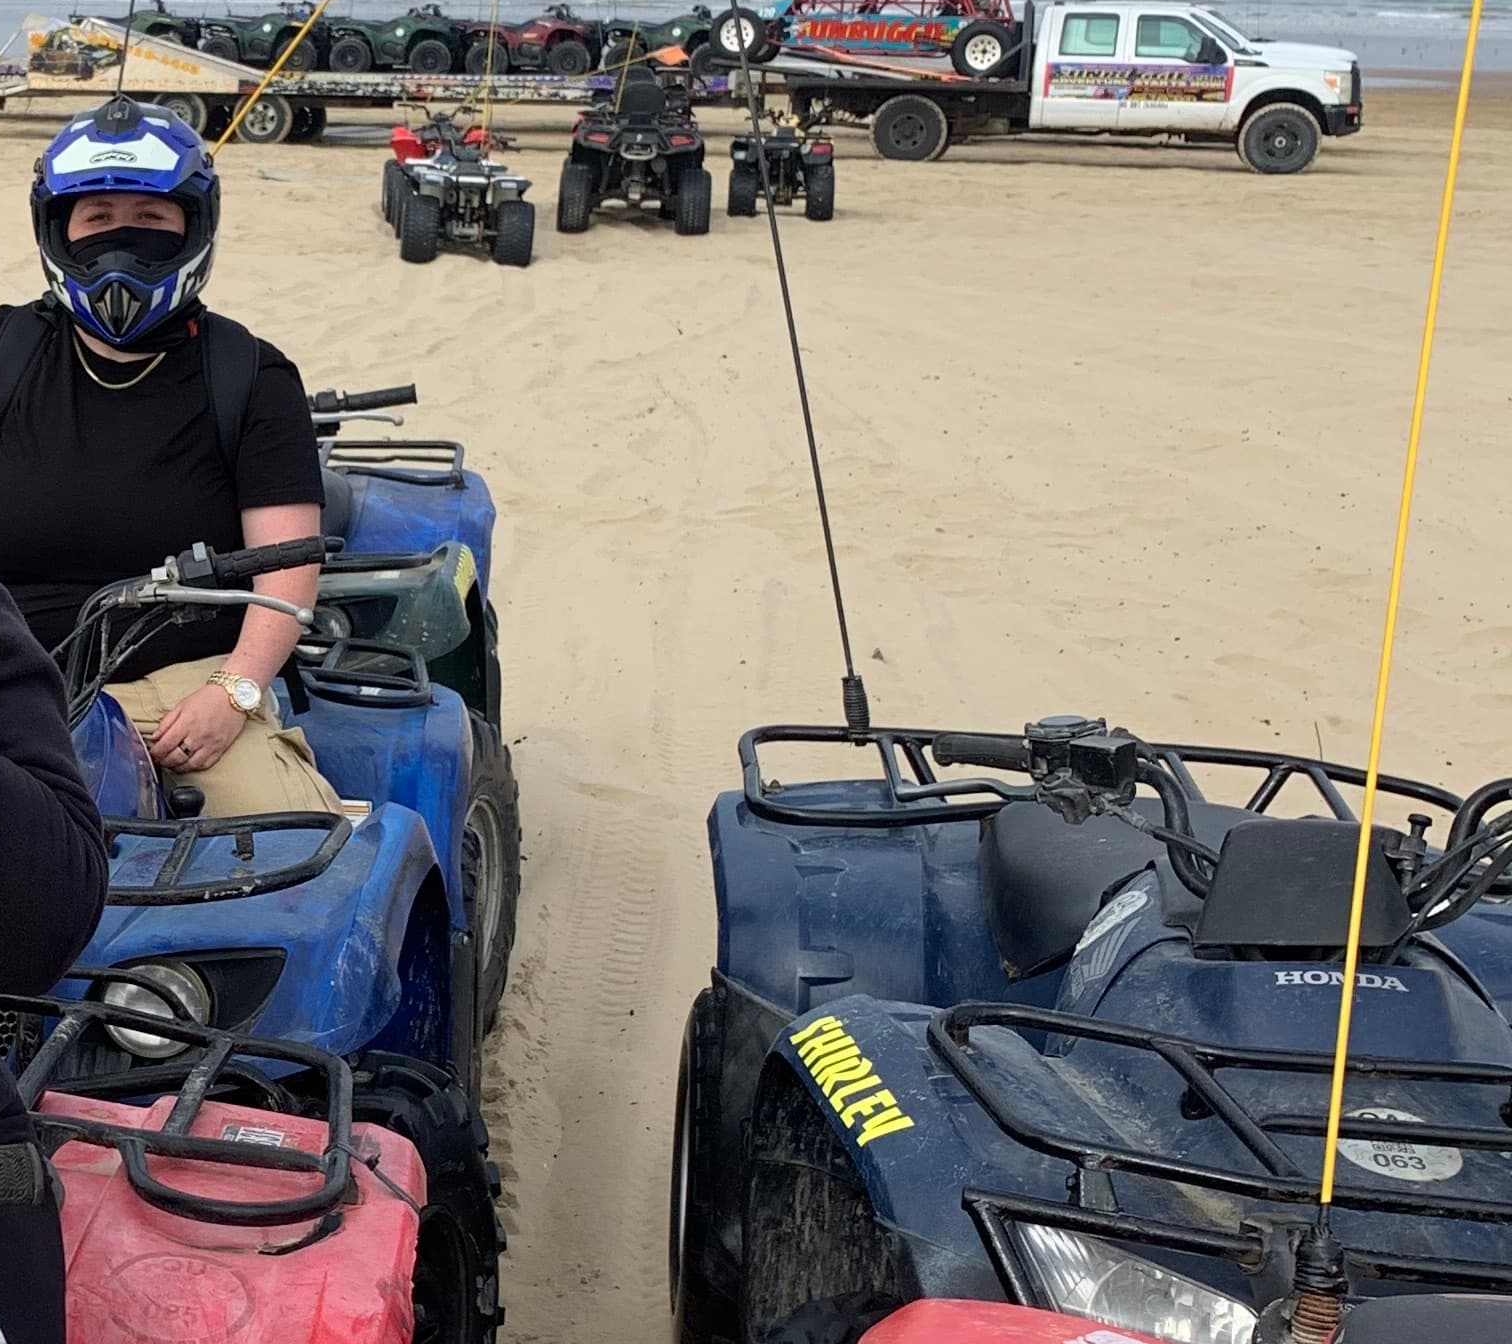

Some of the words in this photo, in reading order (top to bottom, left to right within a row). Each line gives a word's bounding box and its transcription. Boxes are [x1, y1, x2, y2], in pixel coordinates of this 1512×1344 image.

[1274, 970, 1410, 993] HONDA
[789, 1015, 915, 1148] SHIRLEY
[1373, 1152, 1427, 1171] 063
